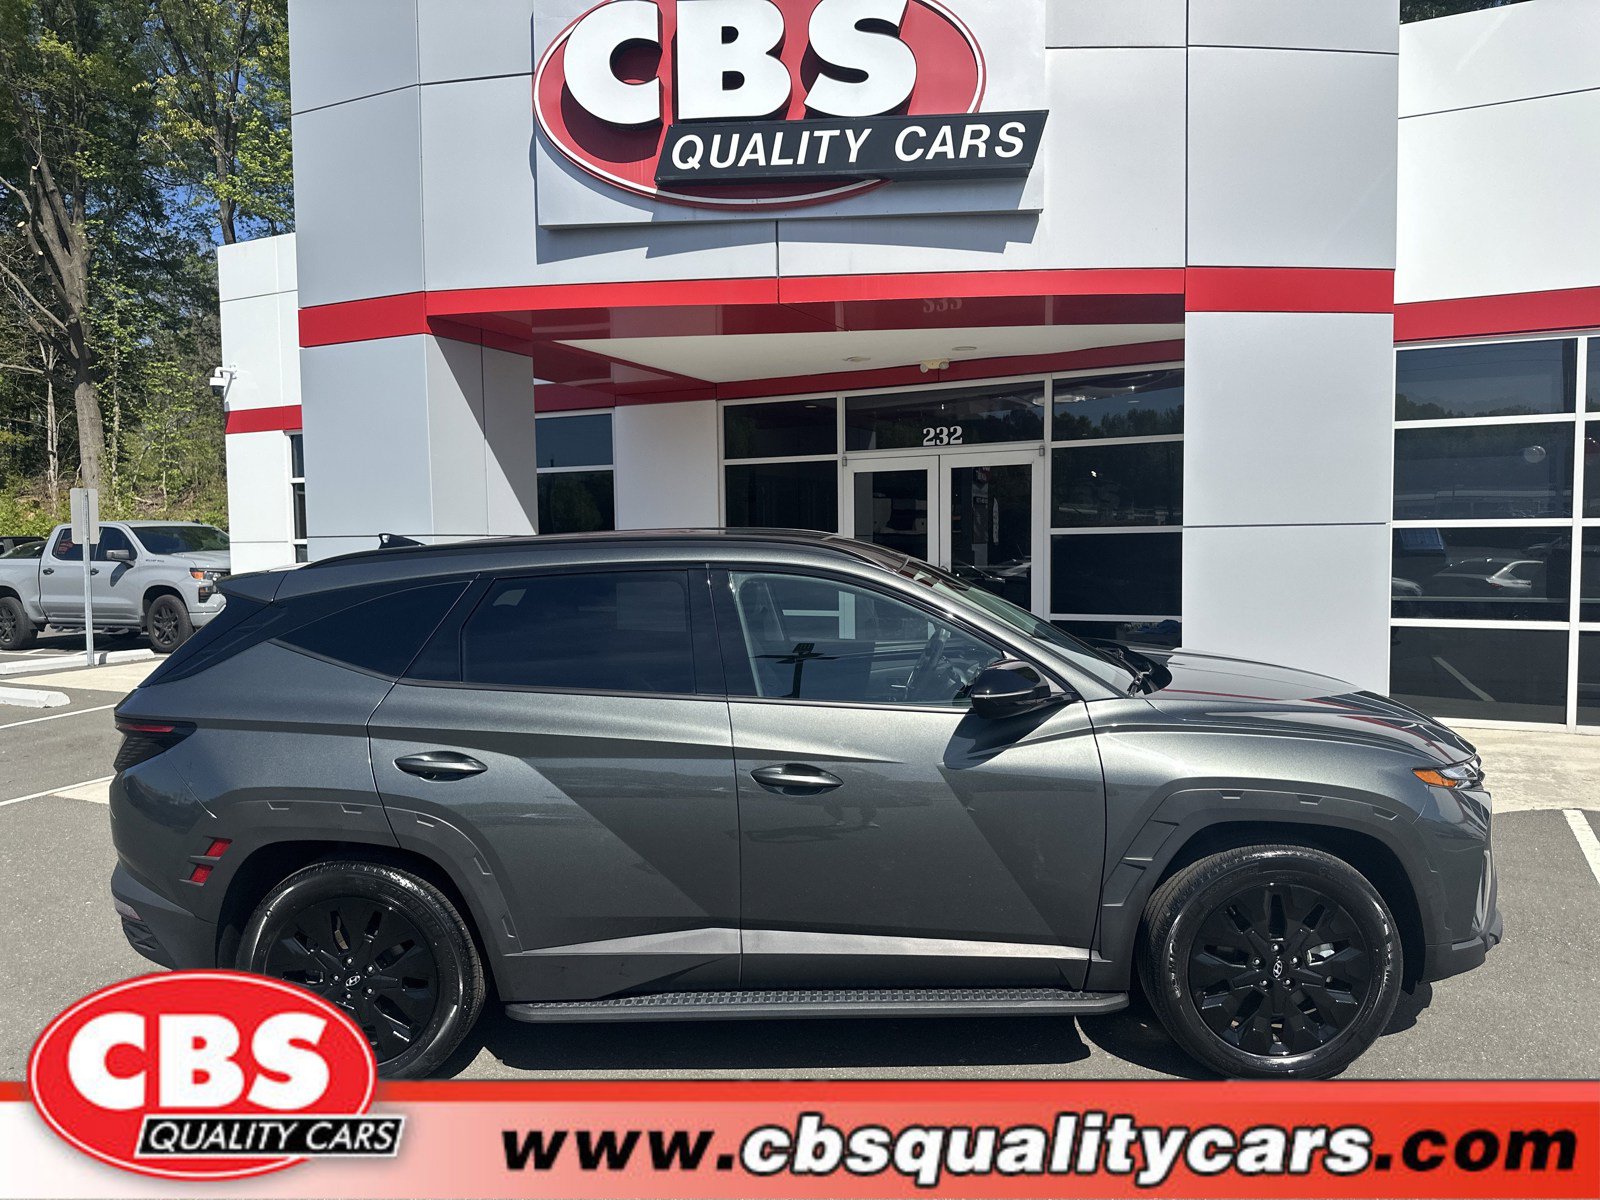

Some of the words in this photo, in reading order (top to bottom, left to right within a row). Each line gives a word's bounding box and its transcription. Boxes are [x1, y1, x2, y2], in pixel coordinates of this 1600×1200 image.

[563, 0, 917, 124] CBS
[672, 130, 873, 169] QUALITY
[895, 122, 1026, 161] CARS
[923, 426, 963, 446] 232
